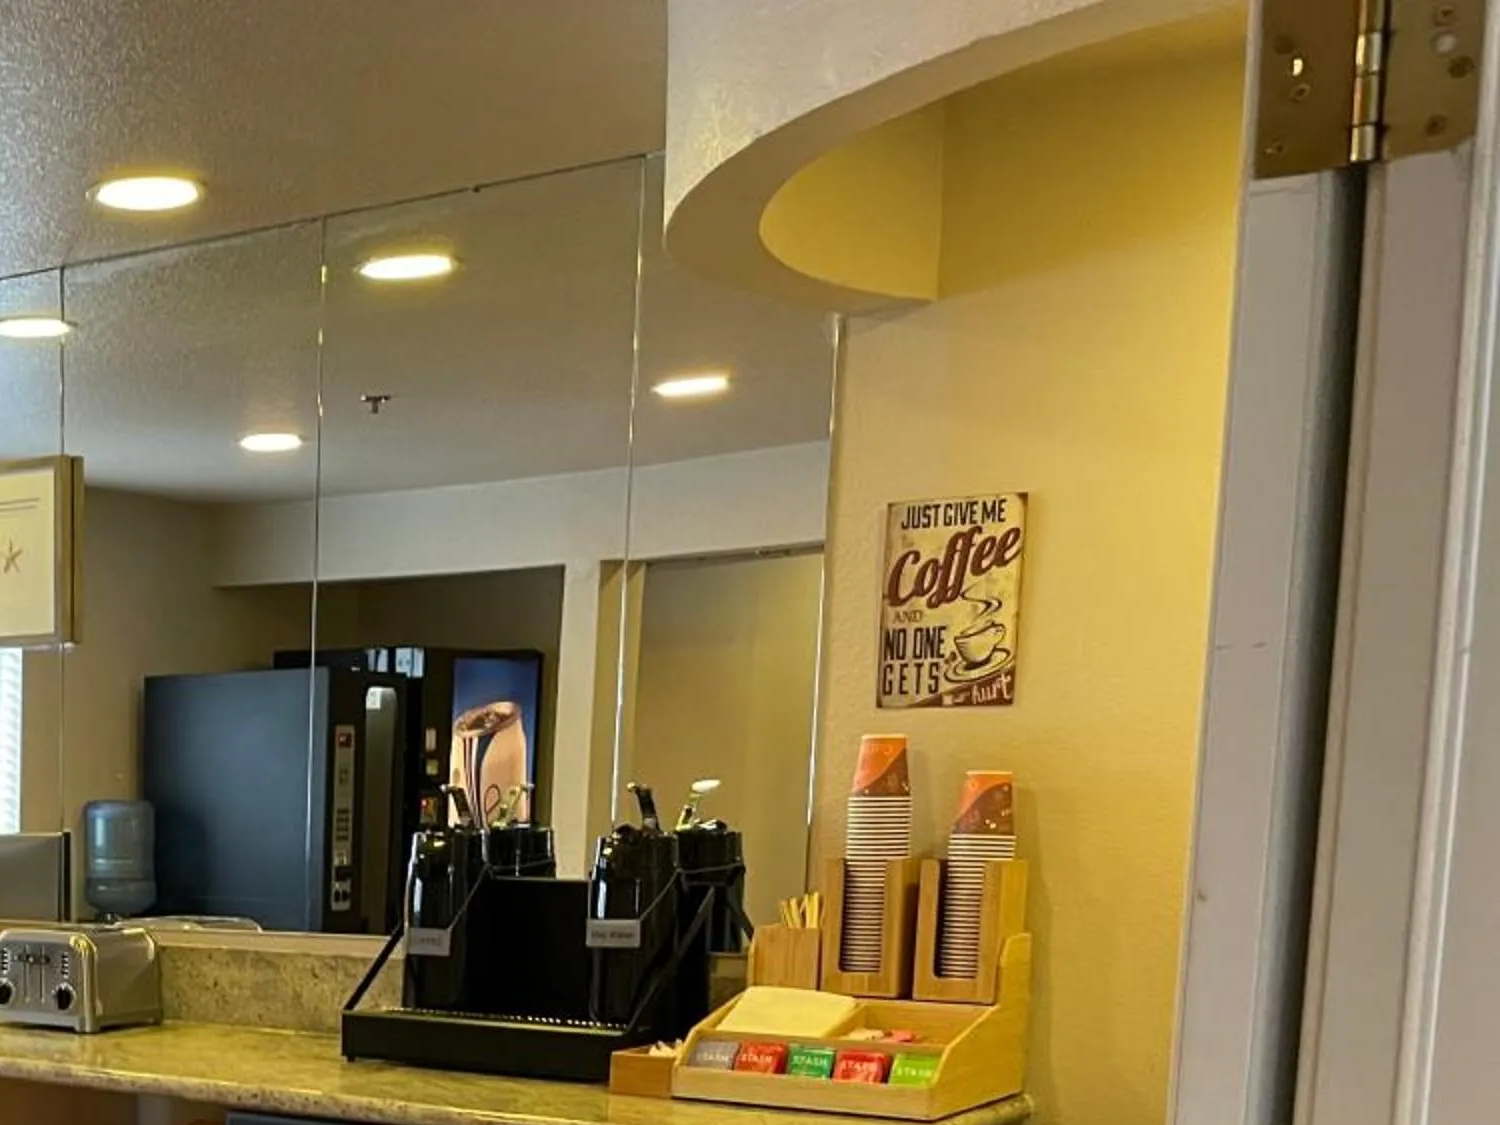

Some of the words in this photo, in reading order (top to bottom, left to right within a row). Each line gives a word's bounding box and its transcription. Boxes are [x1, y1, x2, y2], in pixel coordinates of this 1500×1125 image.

[901, 504, 941, 530] JUST
[943, 501, 978, 526] GIVE
[981, 498, 1007, 523] ME
[887, 525, 1021, 609] Coffee
[884, 628, 907, 660] NO
[912, 625, 947, 659] ONE
[883, 662, 939, 696] GETS
